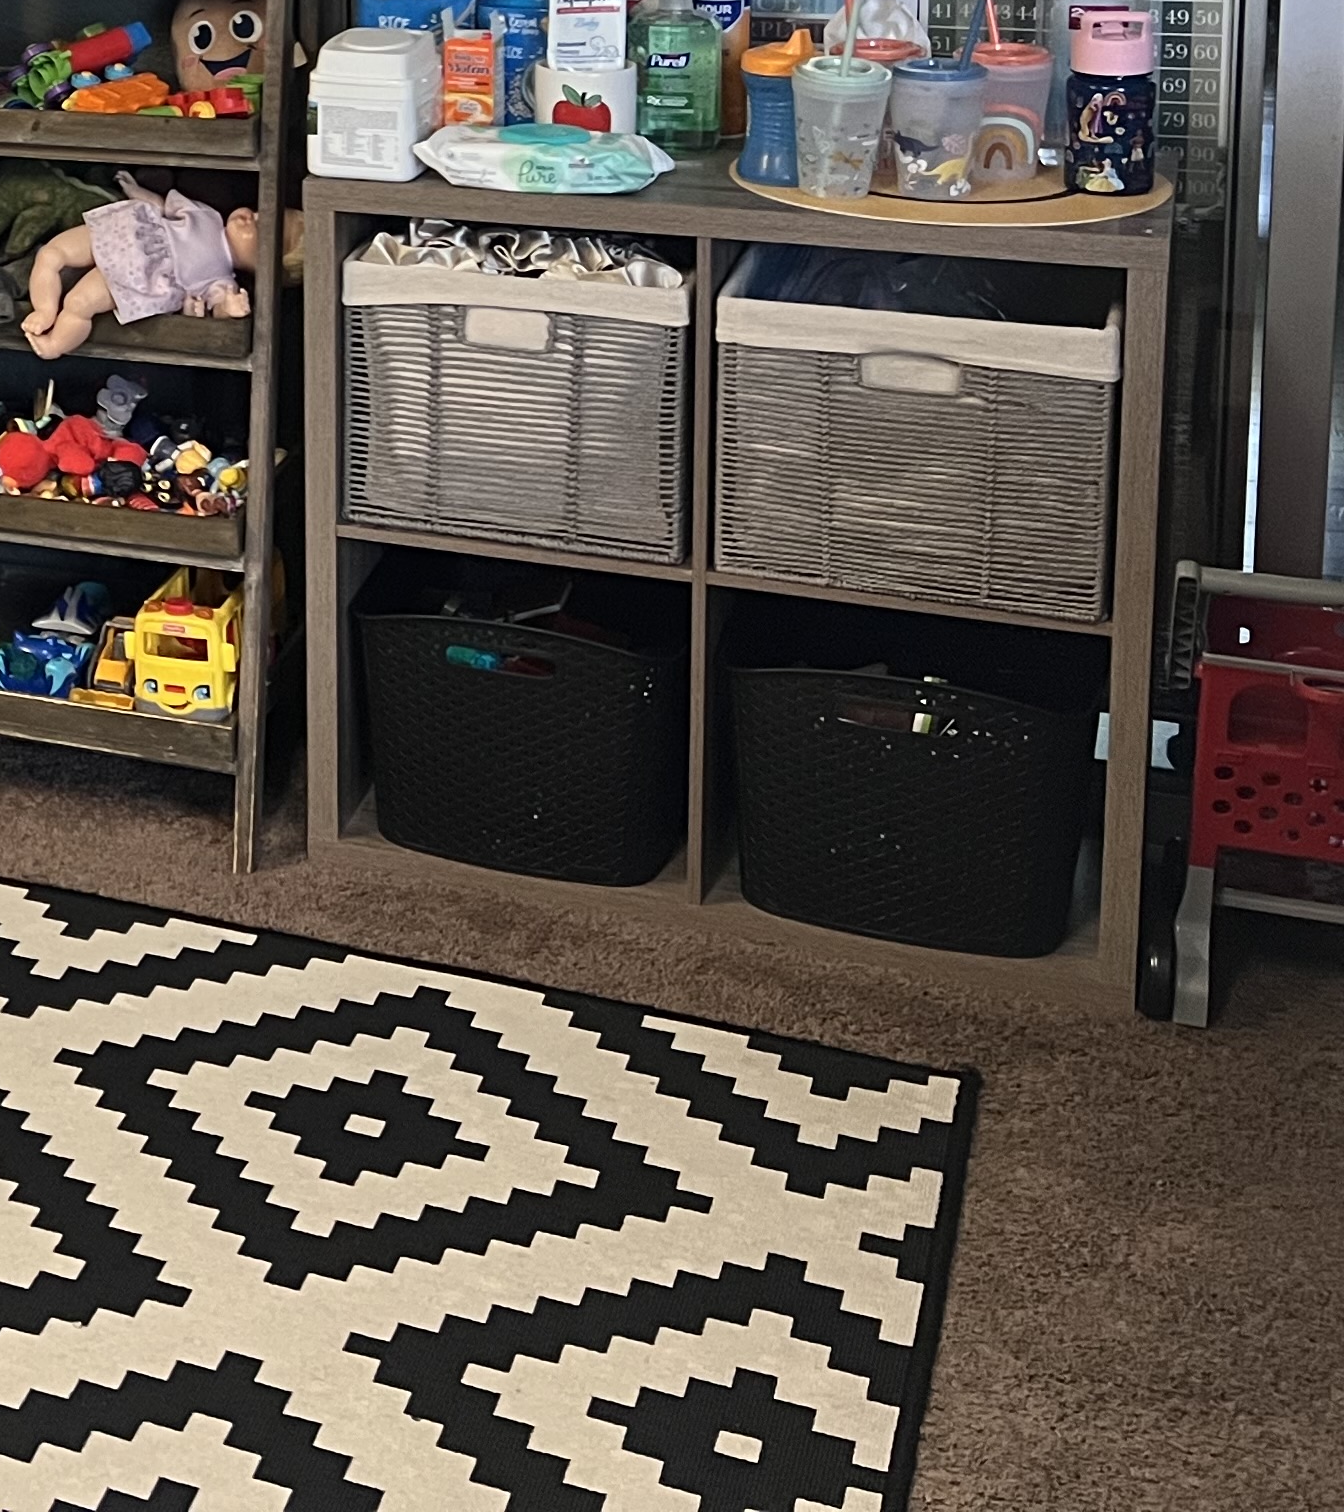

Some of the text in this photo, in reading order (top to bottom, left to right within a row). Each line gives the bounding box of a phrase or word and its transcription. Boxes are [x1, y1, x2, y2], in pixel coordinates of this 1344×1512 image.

[378, 16, 410, 29] RICE
[1165, 9, 1189, 25] 49
[1163, 44, 1188, 60] 59
[650, 54, 688, 68] Purell
[517, 160, 557, 185] Pure
